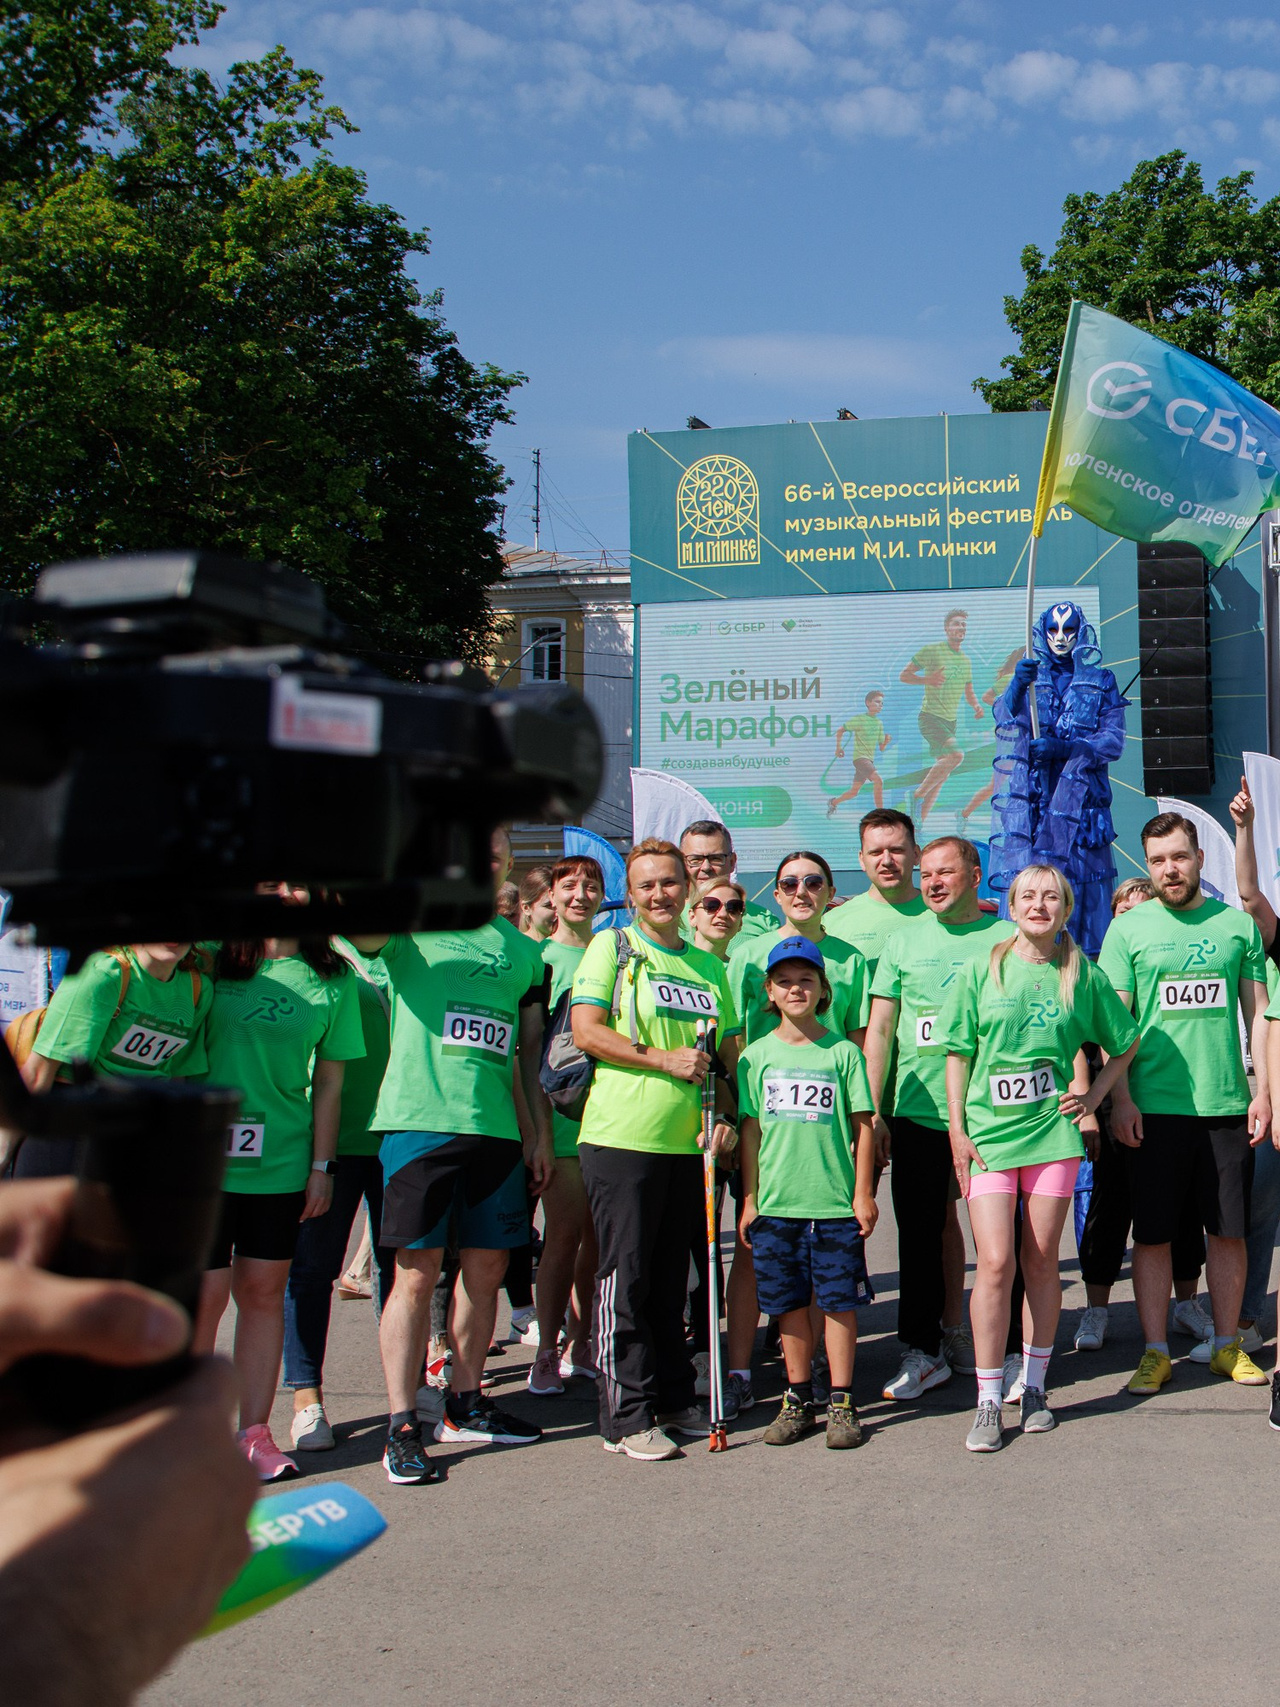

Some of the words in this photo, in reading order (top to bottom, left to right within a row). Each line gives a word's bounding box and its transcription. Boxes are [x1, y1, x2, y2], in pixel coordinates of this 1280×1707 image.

[1165, 398, 1266, 465] СБЕ
[700, 475, 737, 501] 220
[785, 483, 835, 502] 66-й
[843, 474, 1020, 501] Всероссийский
[1064, 452, 1175, 507] оленское
[1178, 500, 1257, 530] отделен
[701, 500, 735, 518] лет
[785, 508, 941, 535] музыкальный
[948, 507, 1073, 529] фестивль
[786, 546, 856, 563] имени
[864, 541, 911, 560] М.И.
[919, 539, 997, 558] Глинки
[734, 622, 765, 632] СБЕР
[660, 667, 821, 704] Зелёный
[660, 706, 832, 749] Марафон
[660, 755, 791, 770] #создаваябудущее
[714, 801, 763, 816] юня
[658, 985, 712, 1010] 0110
[1165, 983, 1220, 1005] 0407
[450, 1018, 507, 1049] 0502
[790, 1084, 833, 1109] 128
[997, 1071, 1052, 1100] 0212
